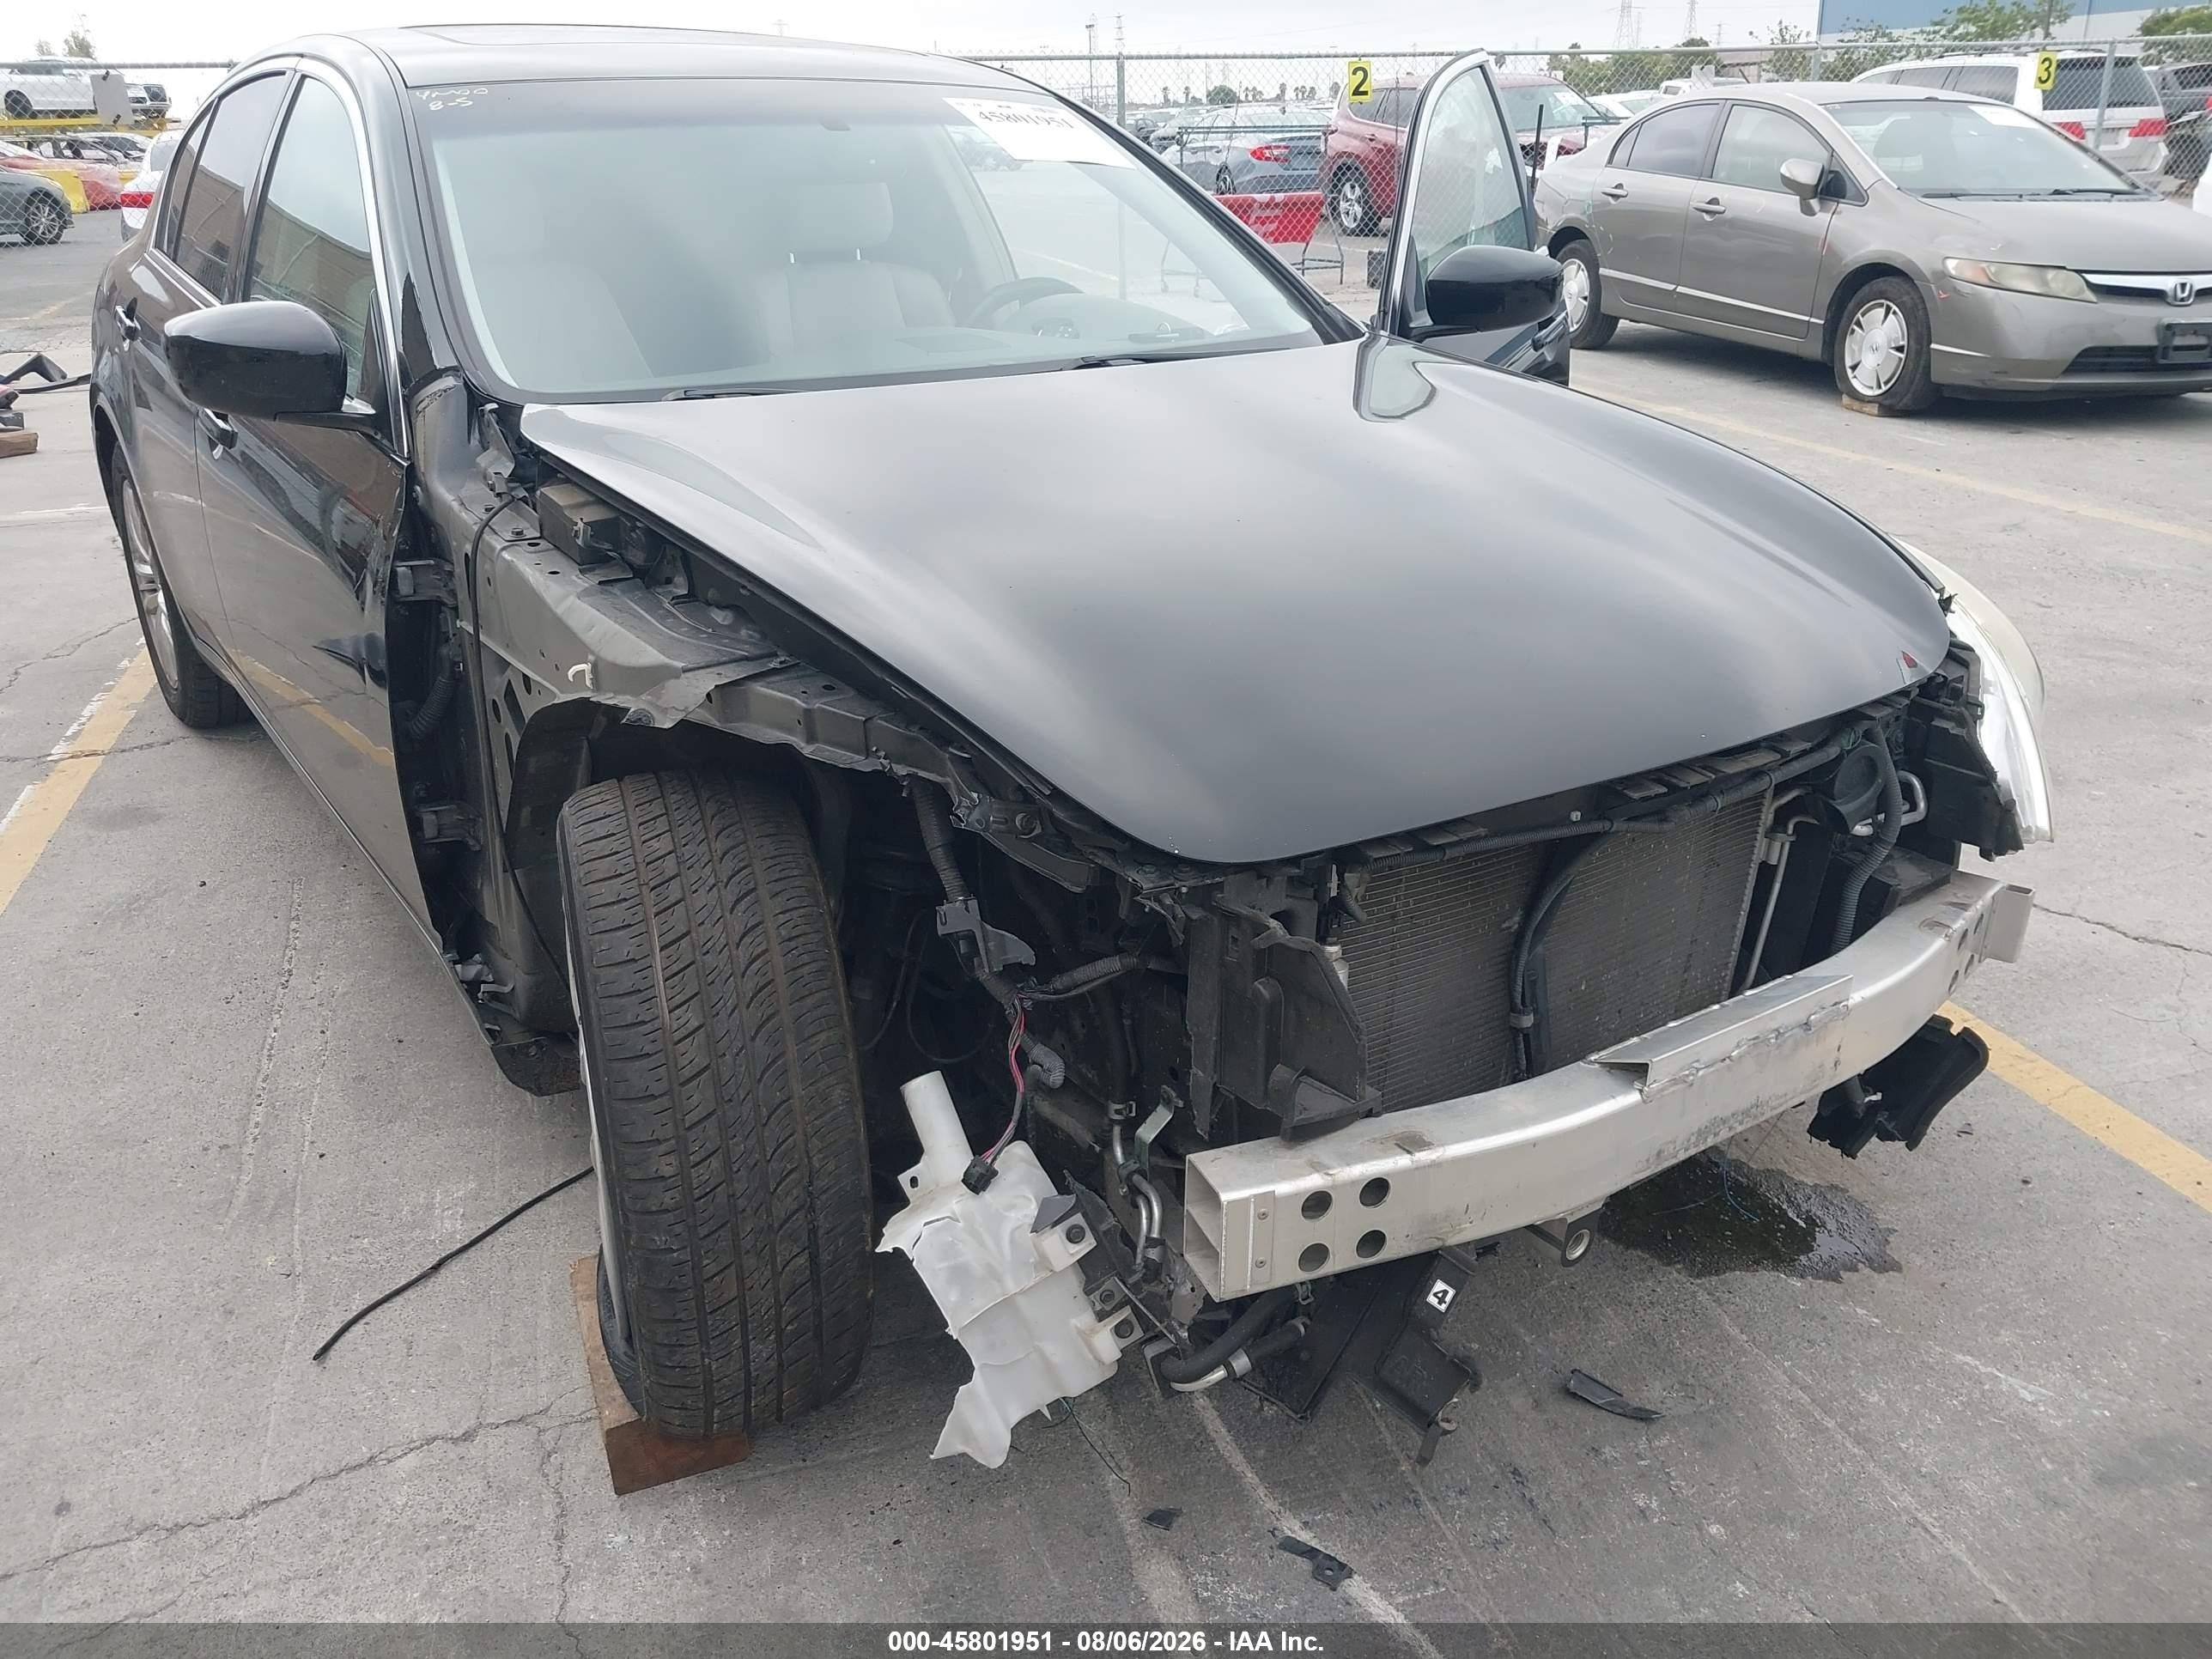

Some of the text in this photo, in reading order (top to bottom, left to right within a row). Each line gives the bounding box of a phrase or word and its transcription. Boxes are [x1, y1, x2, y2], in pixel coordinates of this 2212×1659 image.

[1351, 66, 1369, 96] 2
[2038, 57, 2053, 84] 3
[1432, 1288, 1449, 1306] 4
